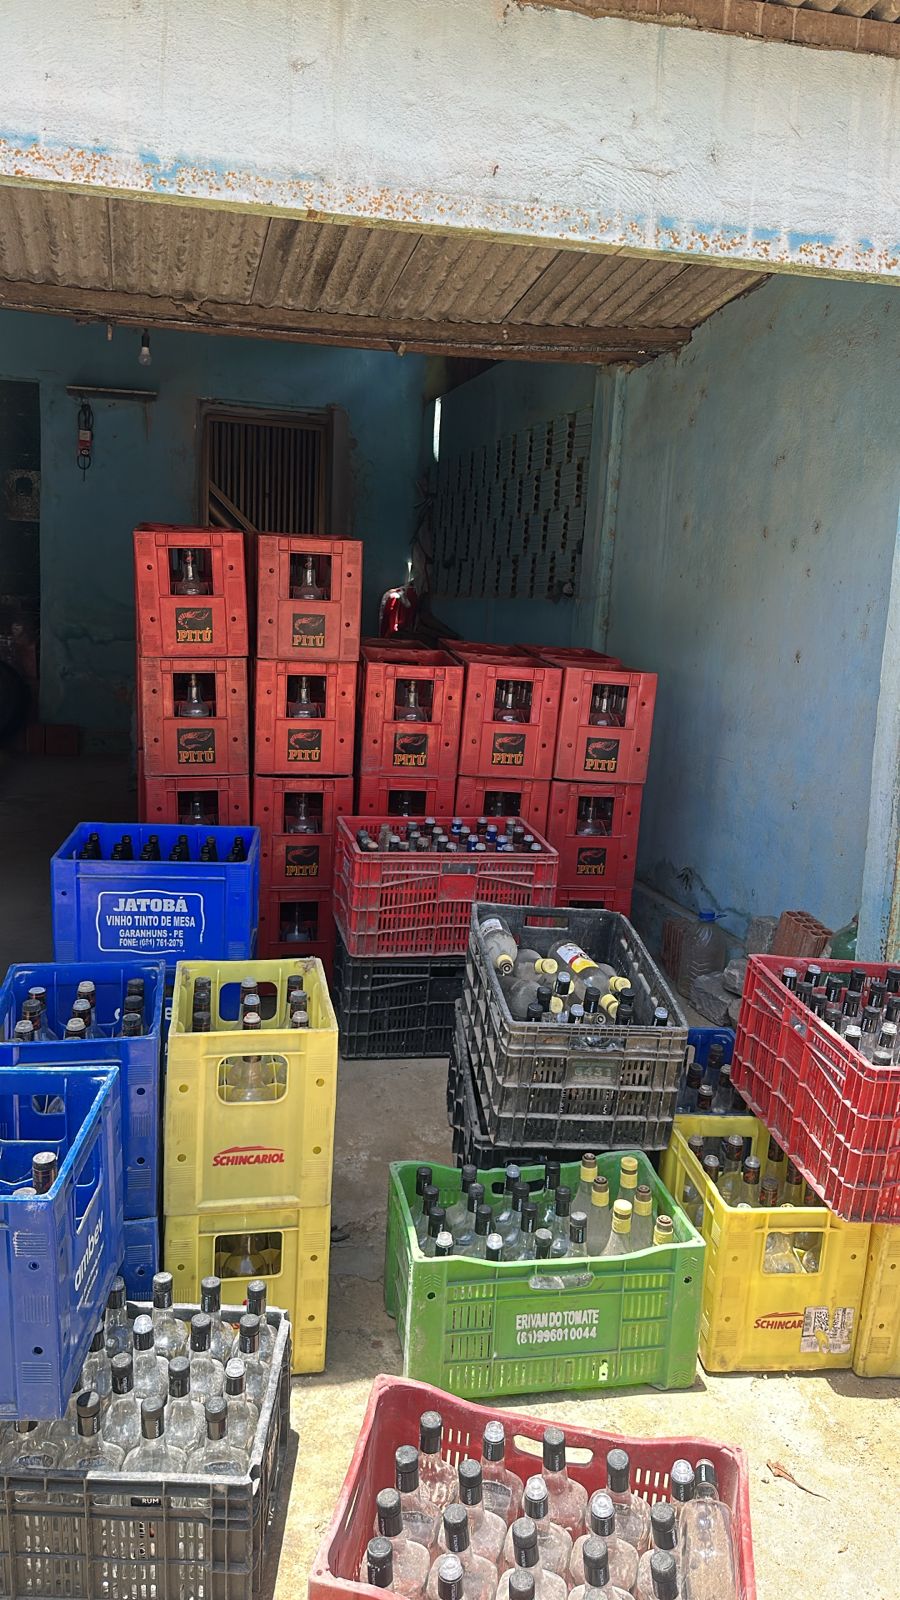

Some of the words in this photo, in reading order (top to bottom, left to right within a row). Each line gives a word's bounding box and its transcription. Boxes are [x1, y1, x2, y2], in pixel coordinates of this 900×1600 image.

[177, 627, 212, 642] PITÚ
[292, 633, 325, 647] PITÚ
[178, 748, 215, 763] PITÚ
[288, 747, 320, 761] PITÚ
[393, 752, 427, 766] PITÚ
[492, 751, 524, 764] PITÚ
[584, 757, 617, 771] PITÚ
[286, 862, 318, 876] PITÚ
[113, 896, 188, 912] JATOBÁ
[106, 915, 132, 926] VINHO
[134, 915, 159, 926] TINTO
[161, 916, 172, 927] DE
[173, 916, 196, 927] MESA
[119, 929, 168, 938] GARANHUNS
[173, 930, 184, 938] PE
[119, 938, 139, 947] FONE:
[156, 939, 184, 947] 761-2079
[212, 1152, 285, 1167] SCHINCARIOL
[74, 1209, 104, 1291] ambev
[515, 1312, 548, 1330] ERIVAN
[549, 1311, 562, 1328] DO
[563, 1309, 600, 1326] TOMATE
[753, 1318, 803, 1330] SCHINCAR
